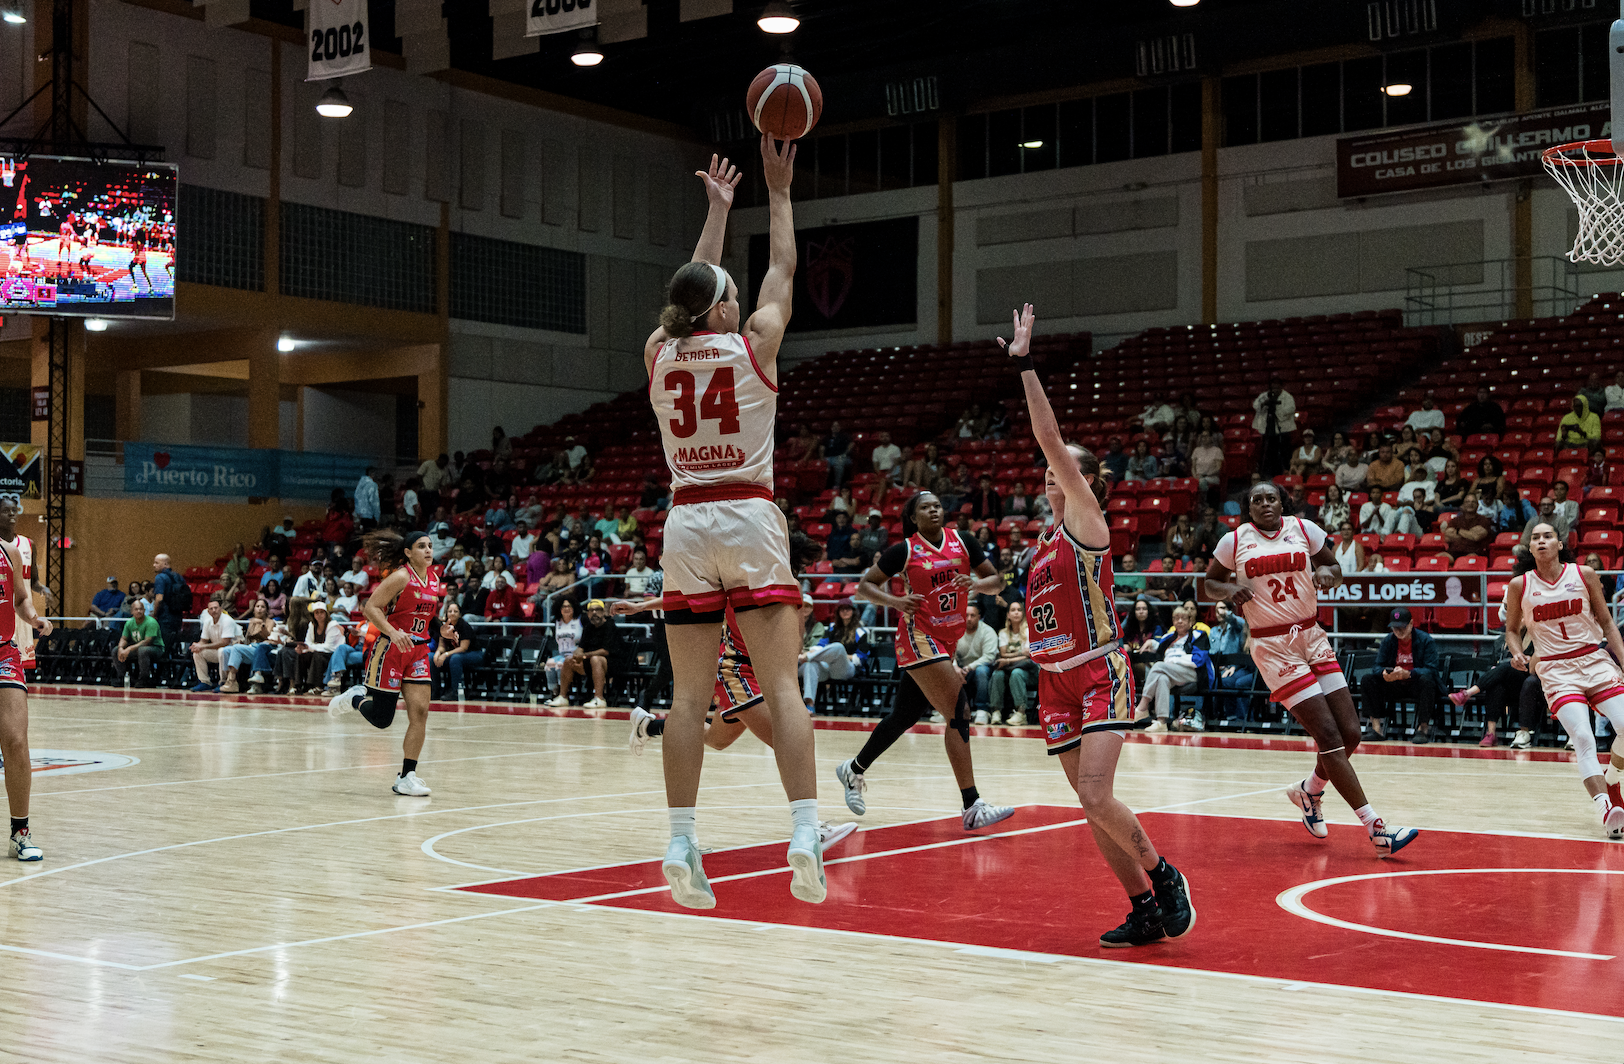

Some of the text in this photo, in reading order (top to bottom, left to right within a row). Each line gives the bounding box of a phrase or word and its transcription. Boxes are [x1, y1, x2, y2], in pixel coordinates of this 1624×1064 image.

[312, 21, 364, 62] 2002
[1350, 143, 1447, 168] COLISEO
[1375, 166, 1415, 179] CASA
[1421, 162, 1441, 174] DE
[1447, 158, 1477, 171] LOS
[675, 348, 720, 362] BERGER
[664, 366, 741, 439] 34
[678, 444, 736, 463] MAGNA
[136, 460, 209, 487] Puerto
[213, 465, 256, 488] Rico
[1267, 576, 1301, 604] 24
[1368, 579, 1437, 601] LOPÉS
[938, 592, 958, 613] 27
[410, 617, 426, 634] 10
[1031, 602, 1058, 634] 32
[1558, 621, 1570, 641] 1
